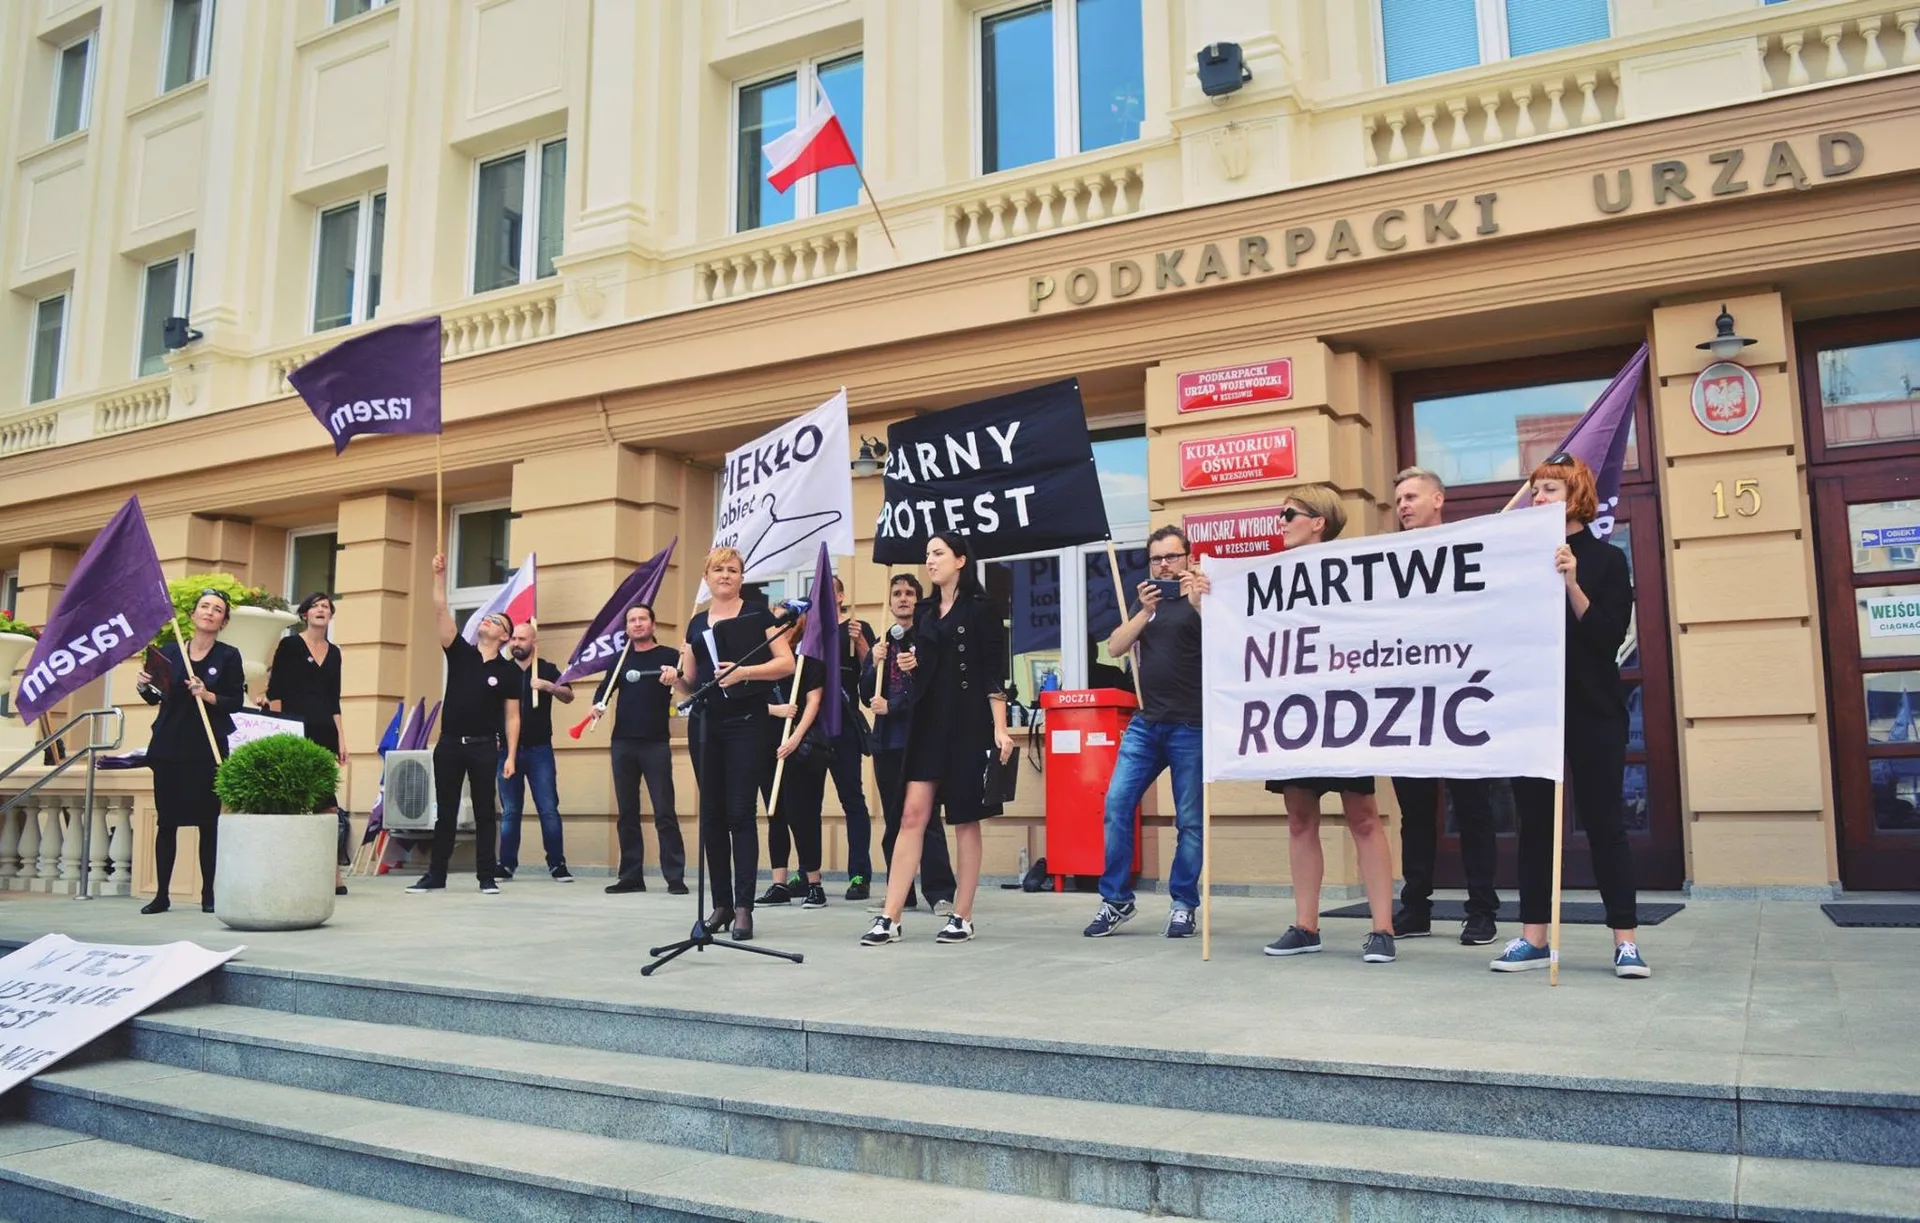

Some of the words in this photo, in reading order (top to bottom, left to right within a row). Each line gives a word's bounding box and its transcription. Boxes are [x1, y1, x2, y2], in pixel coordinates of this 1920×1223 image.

[1027, 193, 1500, 312] PODKARPACKI
[1593, 131, 1865, 214] URZĄD
[1199, 366, 1268, 384] PODKARPACKI
[1186, 434, 1288, 460] KURATORIUM
[1202, 452, 1271, 474] OŚWIATY
[1211, 474, 1219, 482] W
[1220, 468, 1264, 480] RZESZOWIE
[1712, 478, 1763, 519] 15
[719, 494, 757, 533] obiet
[1187, 519, 1236, 543] KOMISARZ
[1239, 514, 1284, 538] WYBORC
[1215, 545, 1223, 555] W
[1225, 540, 1270, 554] RZESZOWIE
[1247, 542, 1486, 617] MARTWE
[1244, 625, 1321, 683] NIE
[1328, 638, 1473, 674] będziemy
[1059, 693, 1096, 704] POCZTA
[1238, 669, 1495, 756] RODZIĆ
[64, 950, 153, 978] TEJ
[0, 1003, 58, 1030] EST
